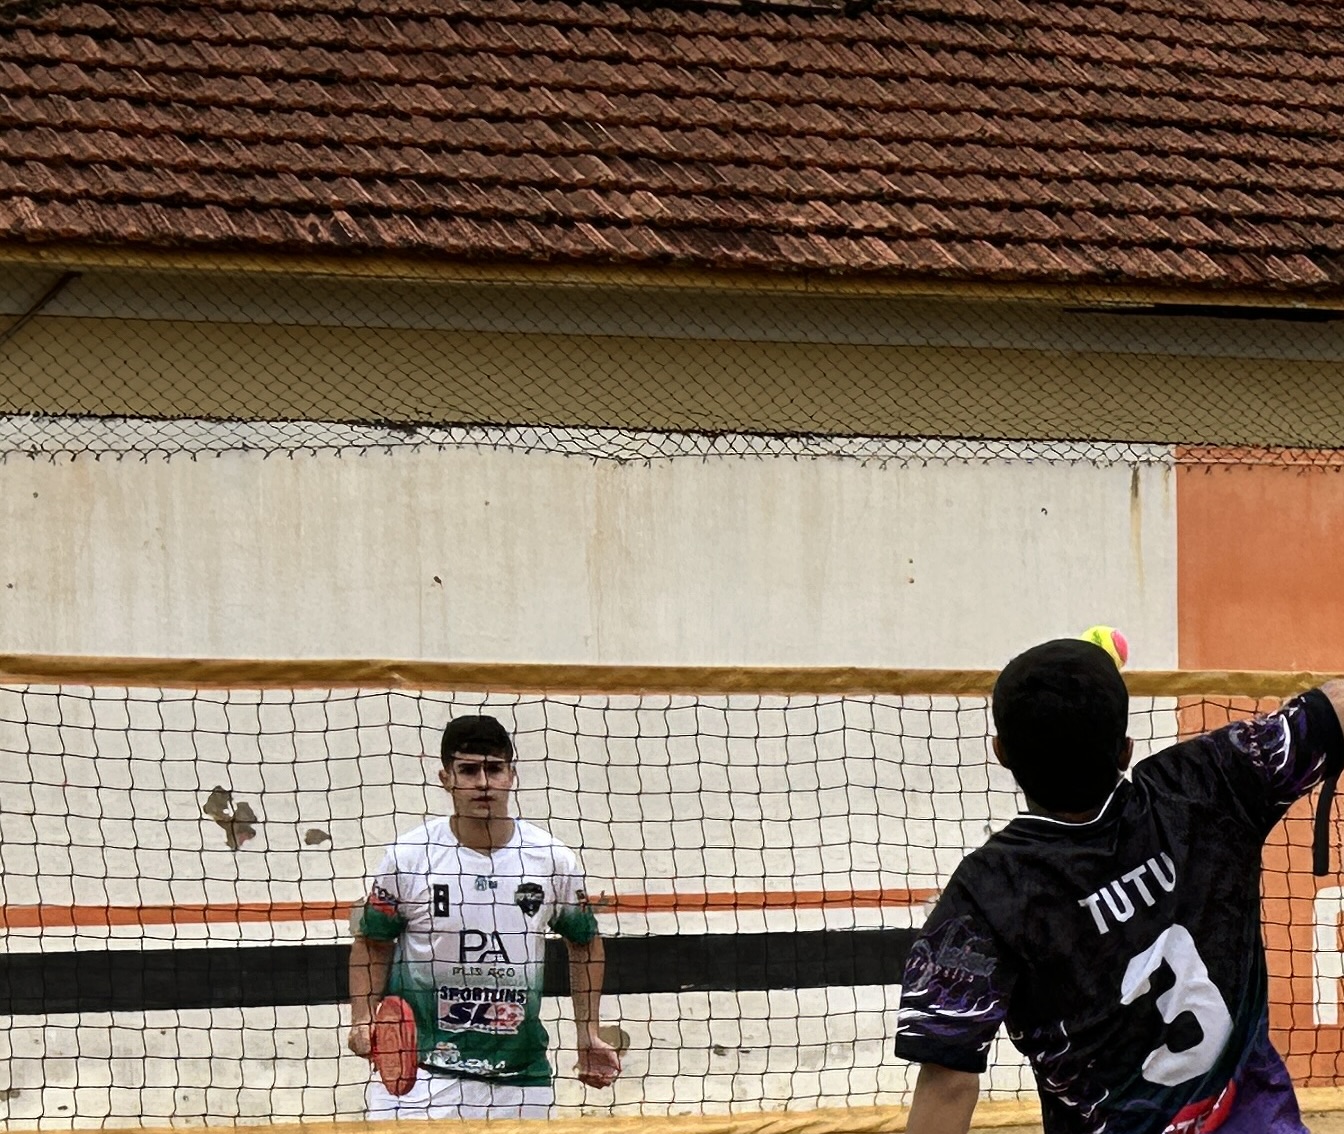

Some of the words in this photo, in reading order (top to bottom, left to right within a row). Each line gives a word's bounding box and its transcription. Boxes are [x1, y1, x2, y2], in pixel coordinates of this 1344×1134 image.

[1078, 852, 1176, 935] TUTU
[459, 929, 511, 964] PA
[1120, 923, 1234, 1087] 3
